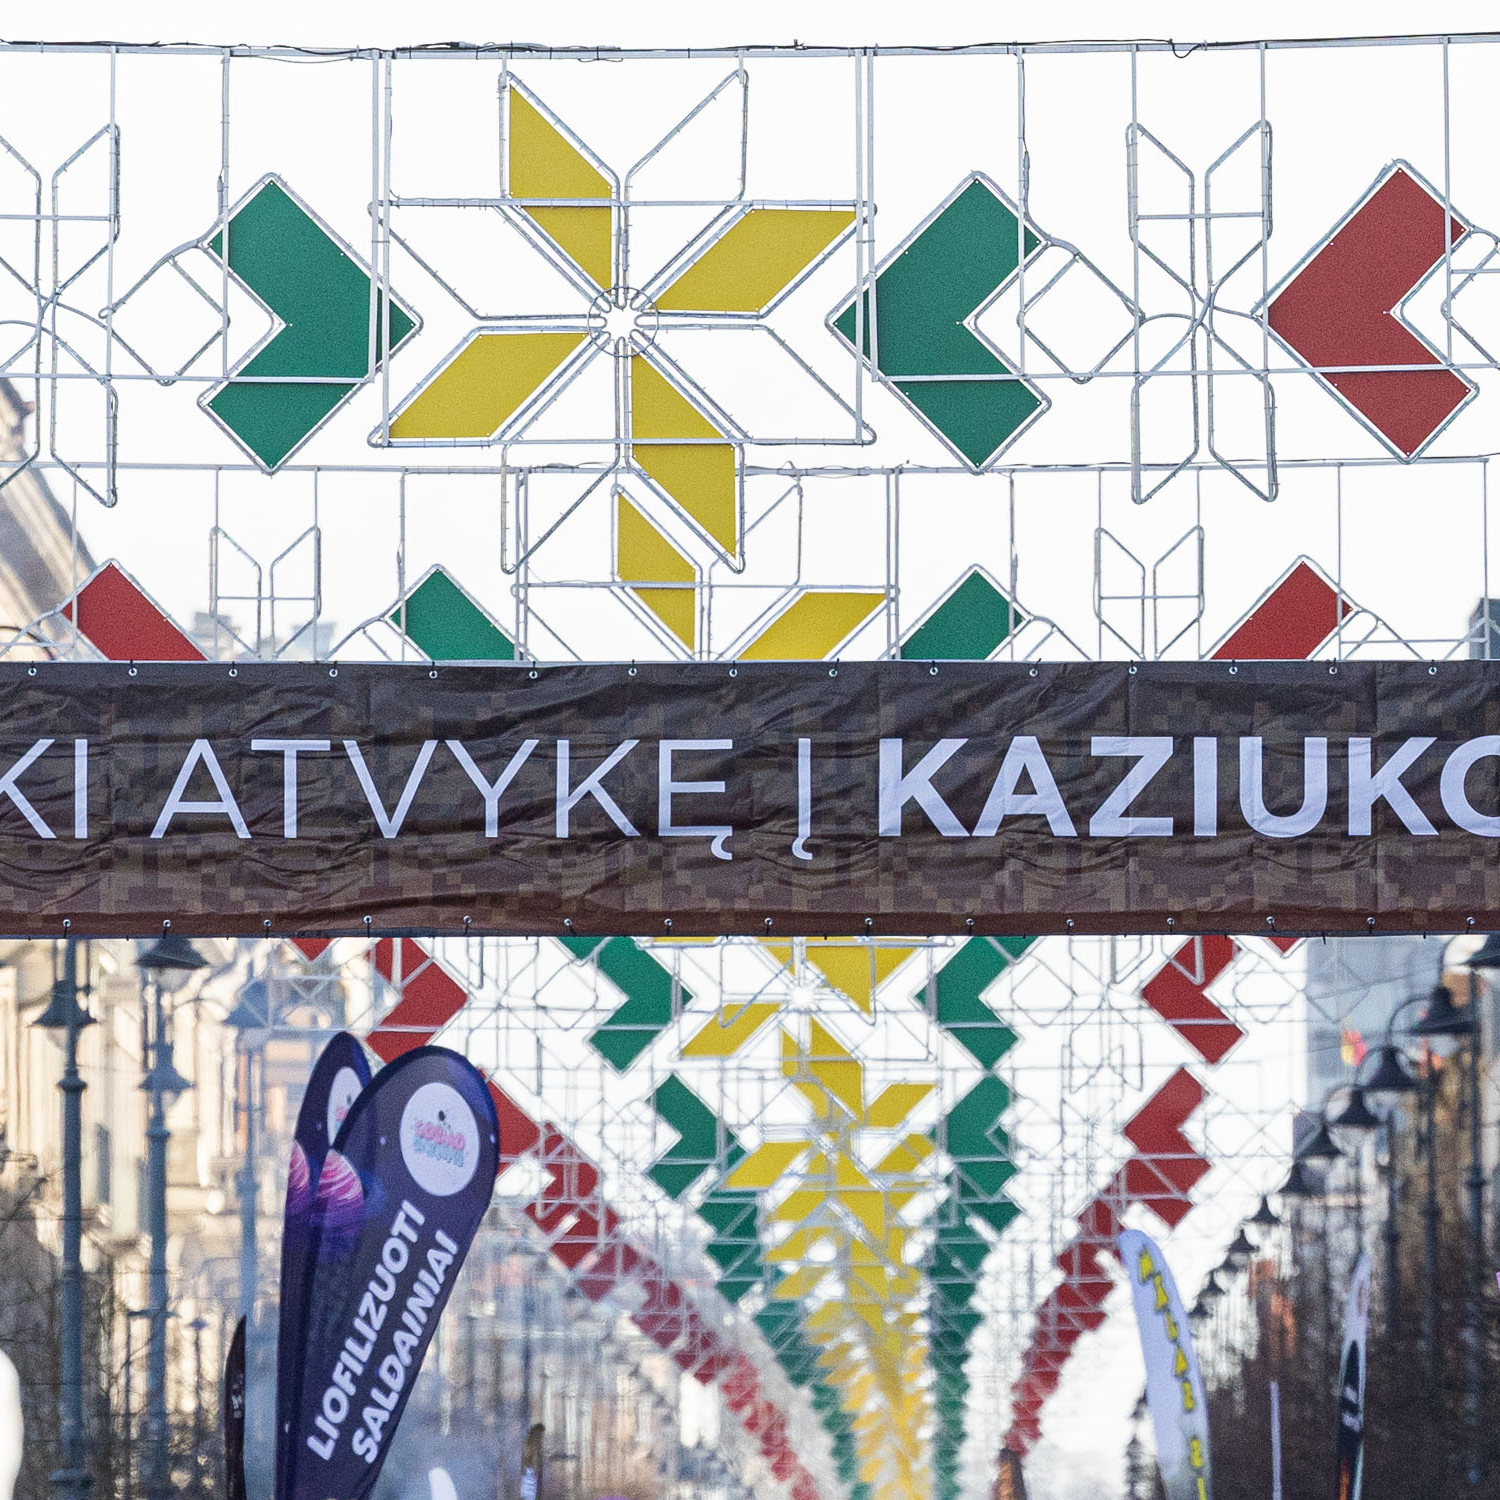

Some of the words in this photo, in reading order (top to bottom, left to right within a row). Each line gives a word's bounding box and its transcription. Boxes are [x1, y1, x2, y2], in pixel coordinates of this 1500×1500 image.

[150, 739, 733, 860] ATVYKĘ
[793, 737, 813, 860] Į
[306, 1200, 426, 1461] LIOFILIZUOTI
[351, 1229, 460, 1464] SALDAINIAI
